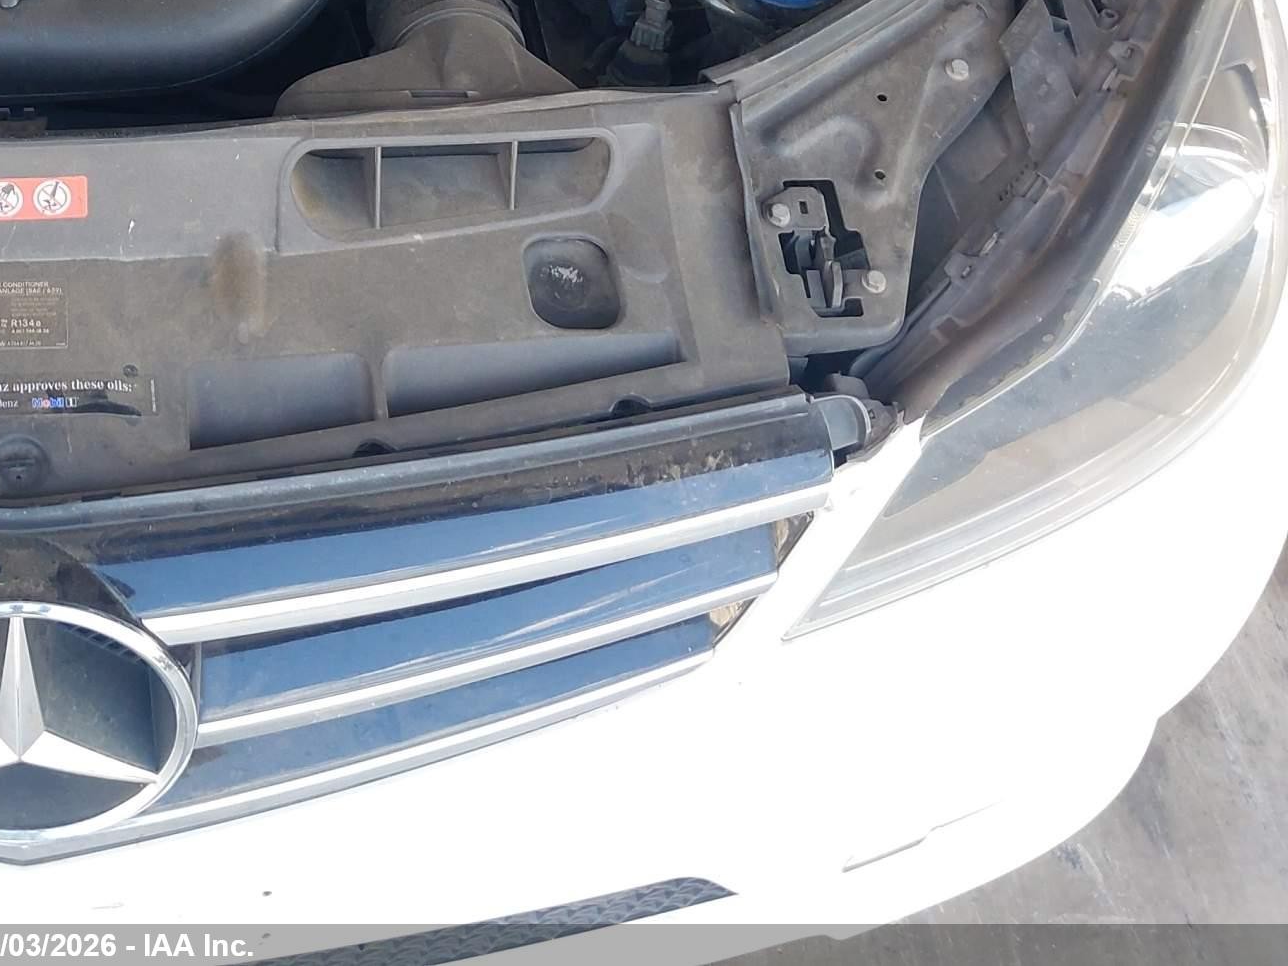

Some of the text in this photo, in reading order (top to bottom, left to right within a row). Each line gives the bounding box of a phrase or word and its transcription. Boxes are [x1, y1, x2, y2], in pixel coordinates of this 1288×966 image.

[12, 380, 68, 394] approves
[71, 378, 104, 391] these
[107, 379, 133, 392] oils:
[31, 397, 65, 409] Mobil
